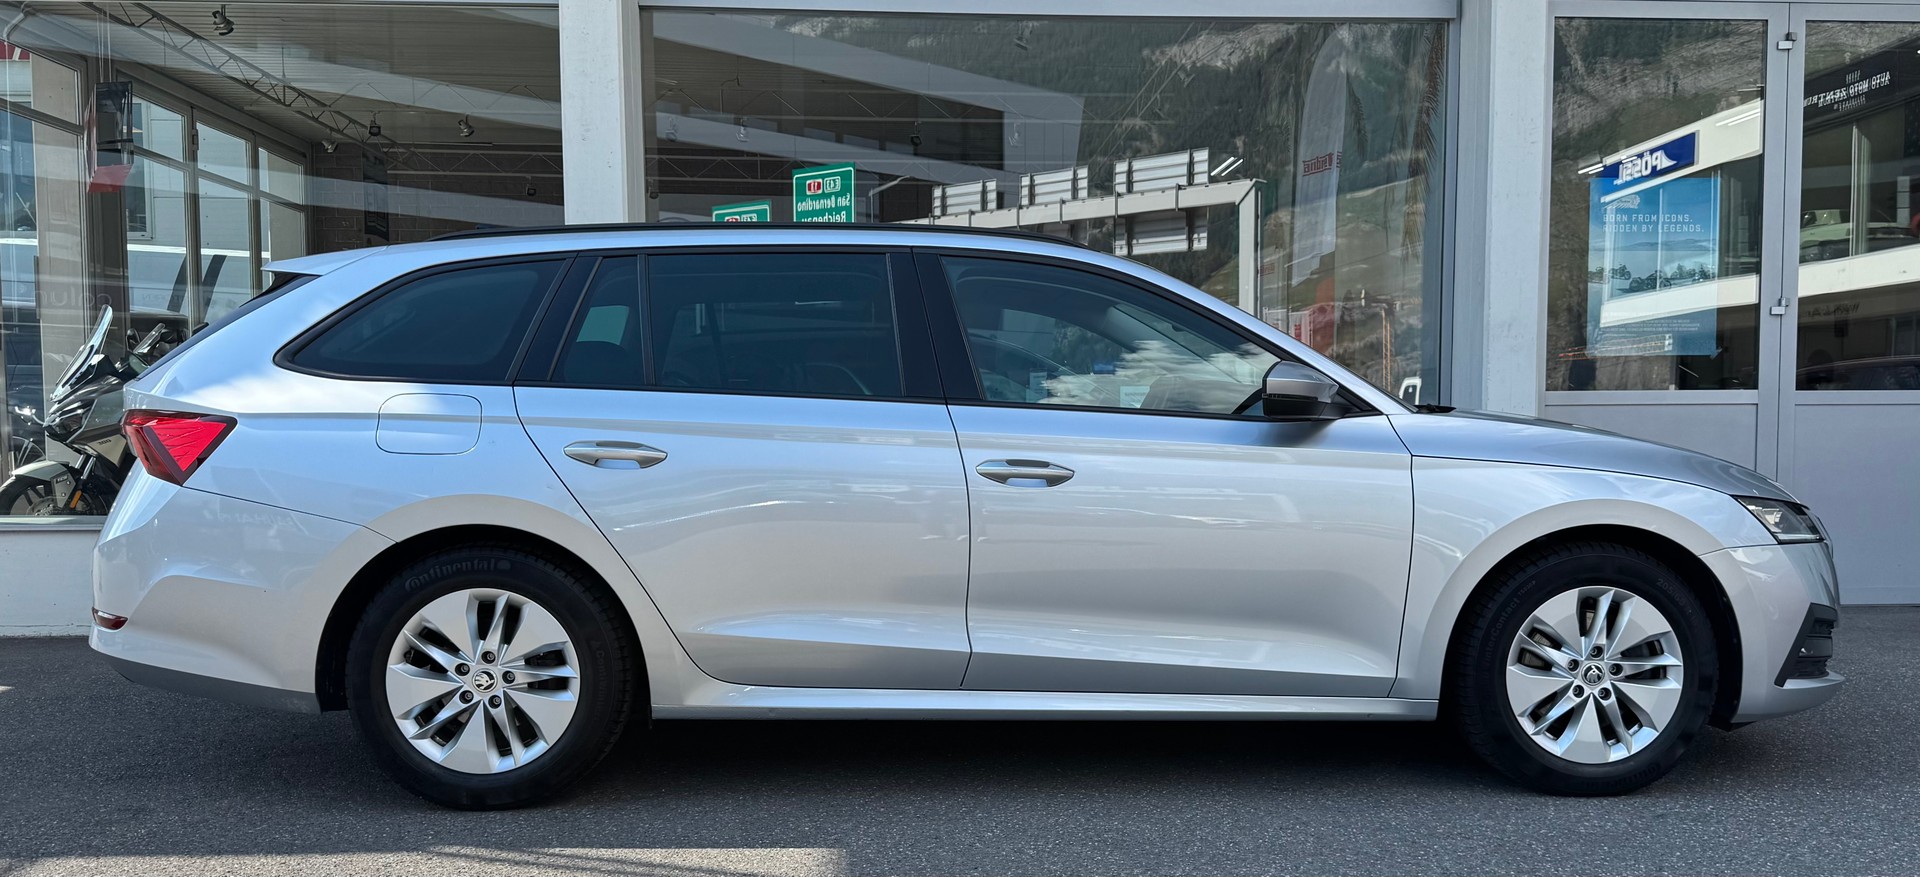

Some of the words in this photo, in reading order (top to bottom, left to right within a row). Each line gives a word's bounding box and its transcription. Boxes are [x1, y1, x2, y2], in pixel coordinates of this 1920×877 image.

[1602, 214, 1628, 222] BORN
[1631, 214, 1657, 222] FROM
[1661, 214, 1693, 222] ICONS.
[1602, 224, 1640, 232] RIDDEN
[1641, 224, 1654, 232] BY
[1658, 224, 1705, 232] LEGENDS.
[404, 558, 496, 592] Continental
